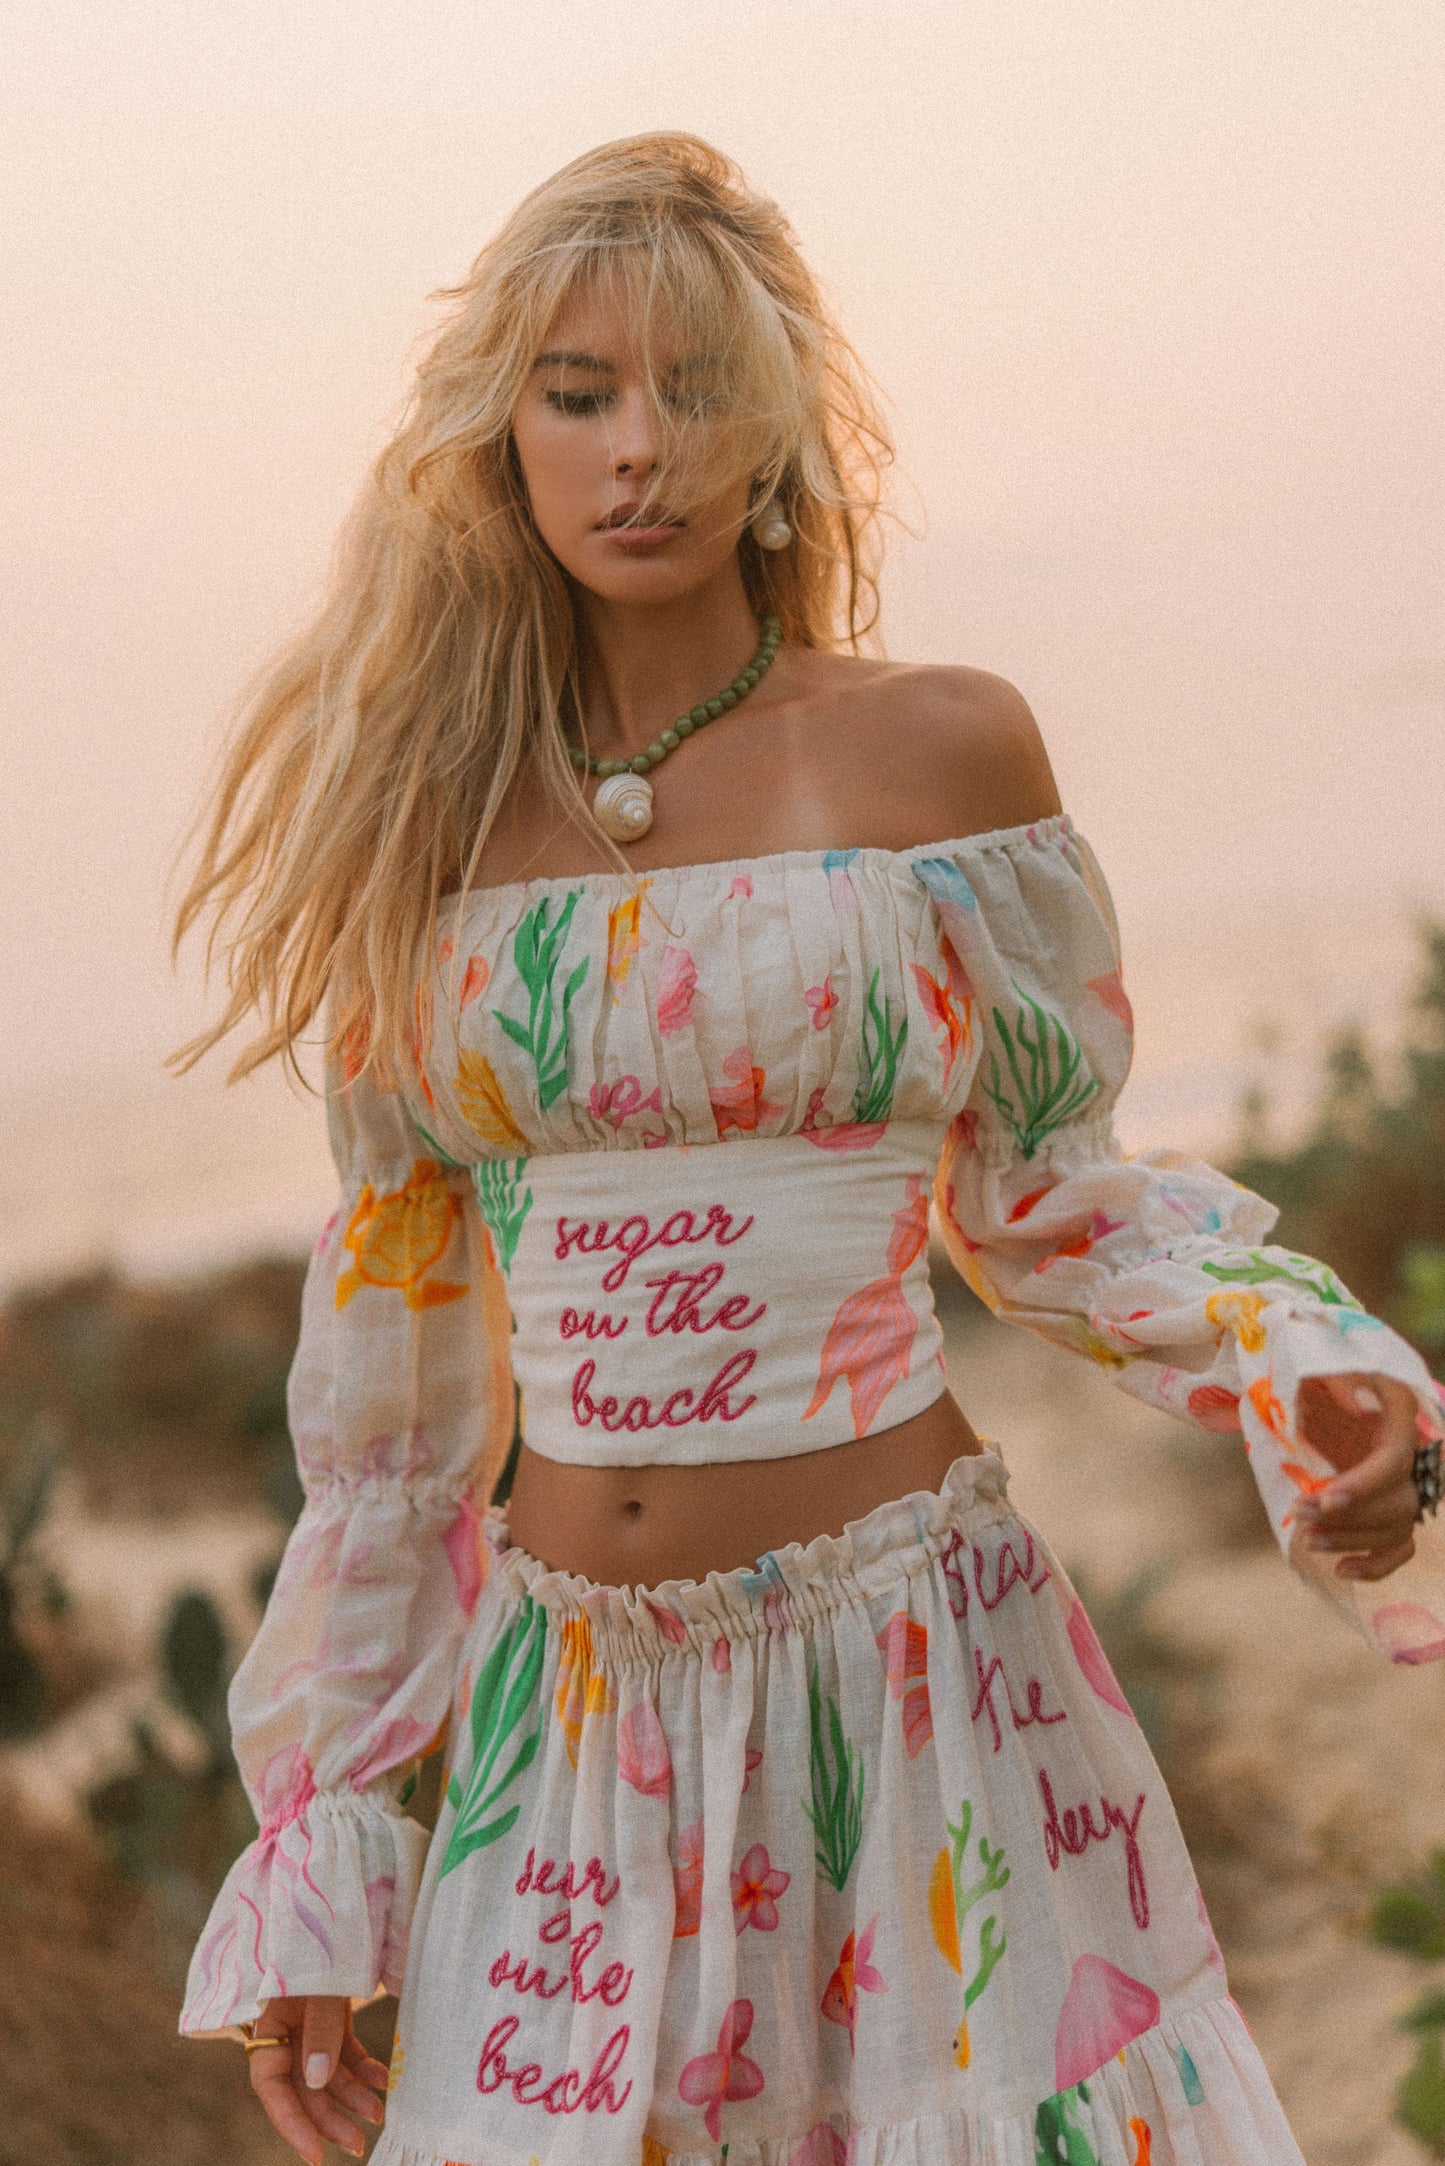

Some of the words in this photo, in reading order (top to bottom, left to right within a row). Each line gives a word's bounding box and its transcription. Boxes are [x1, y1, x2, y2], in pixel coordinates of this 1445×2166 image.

[555, 1204, 754, 1292] sugar
[560, 1307, 629, 1340] on
[644, 1262, 767, 1337] the
[571, 1349, 757, 1432] beach
[570, 1921, 634, 2007] he
